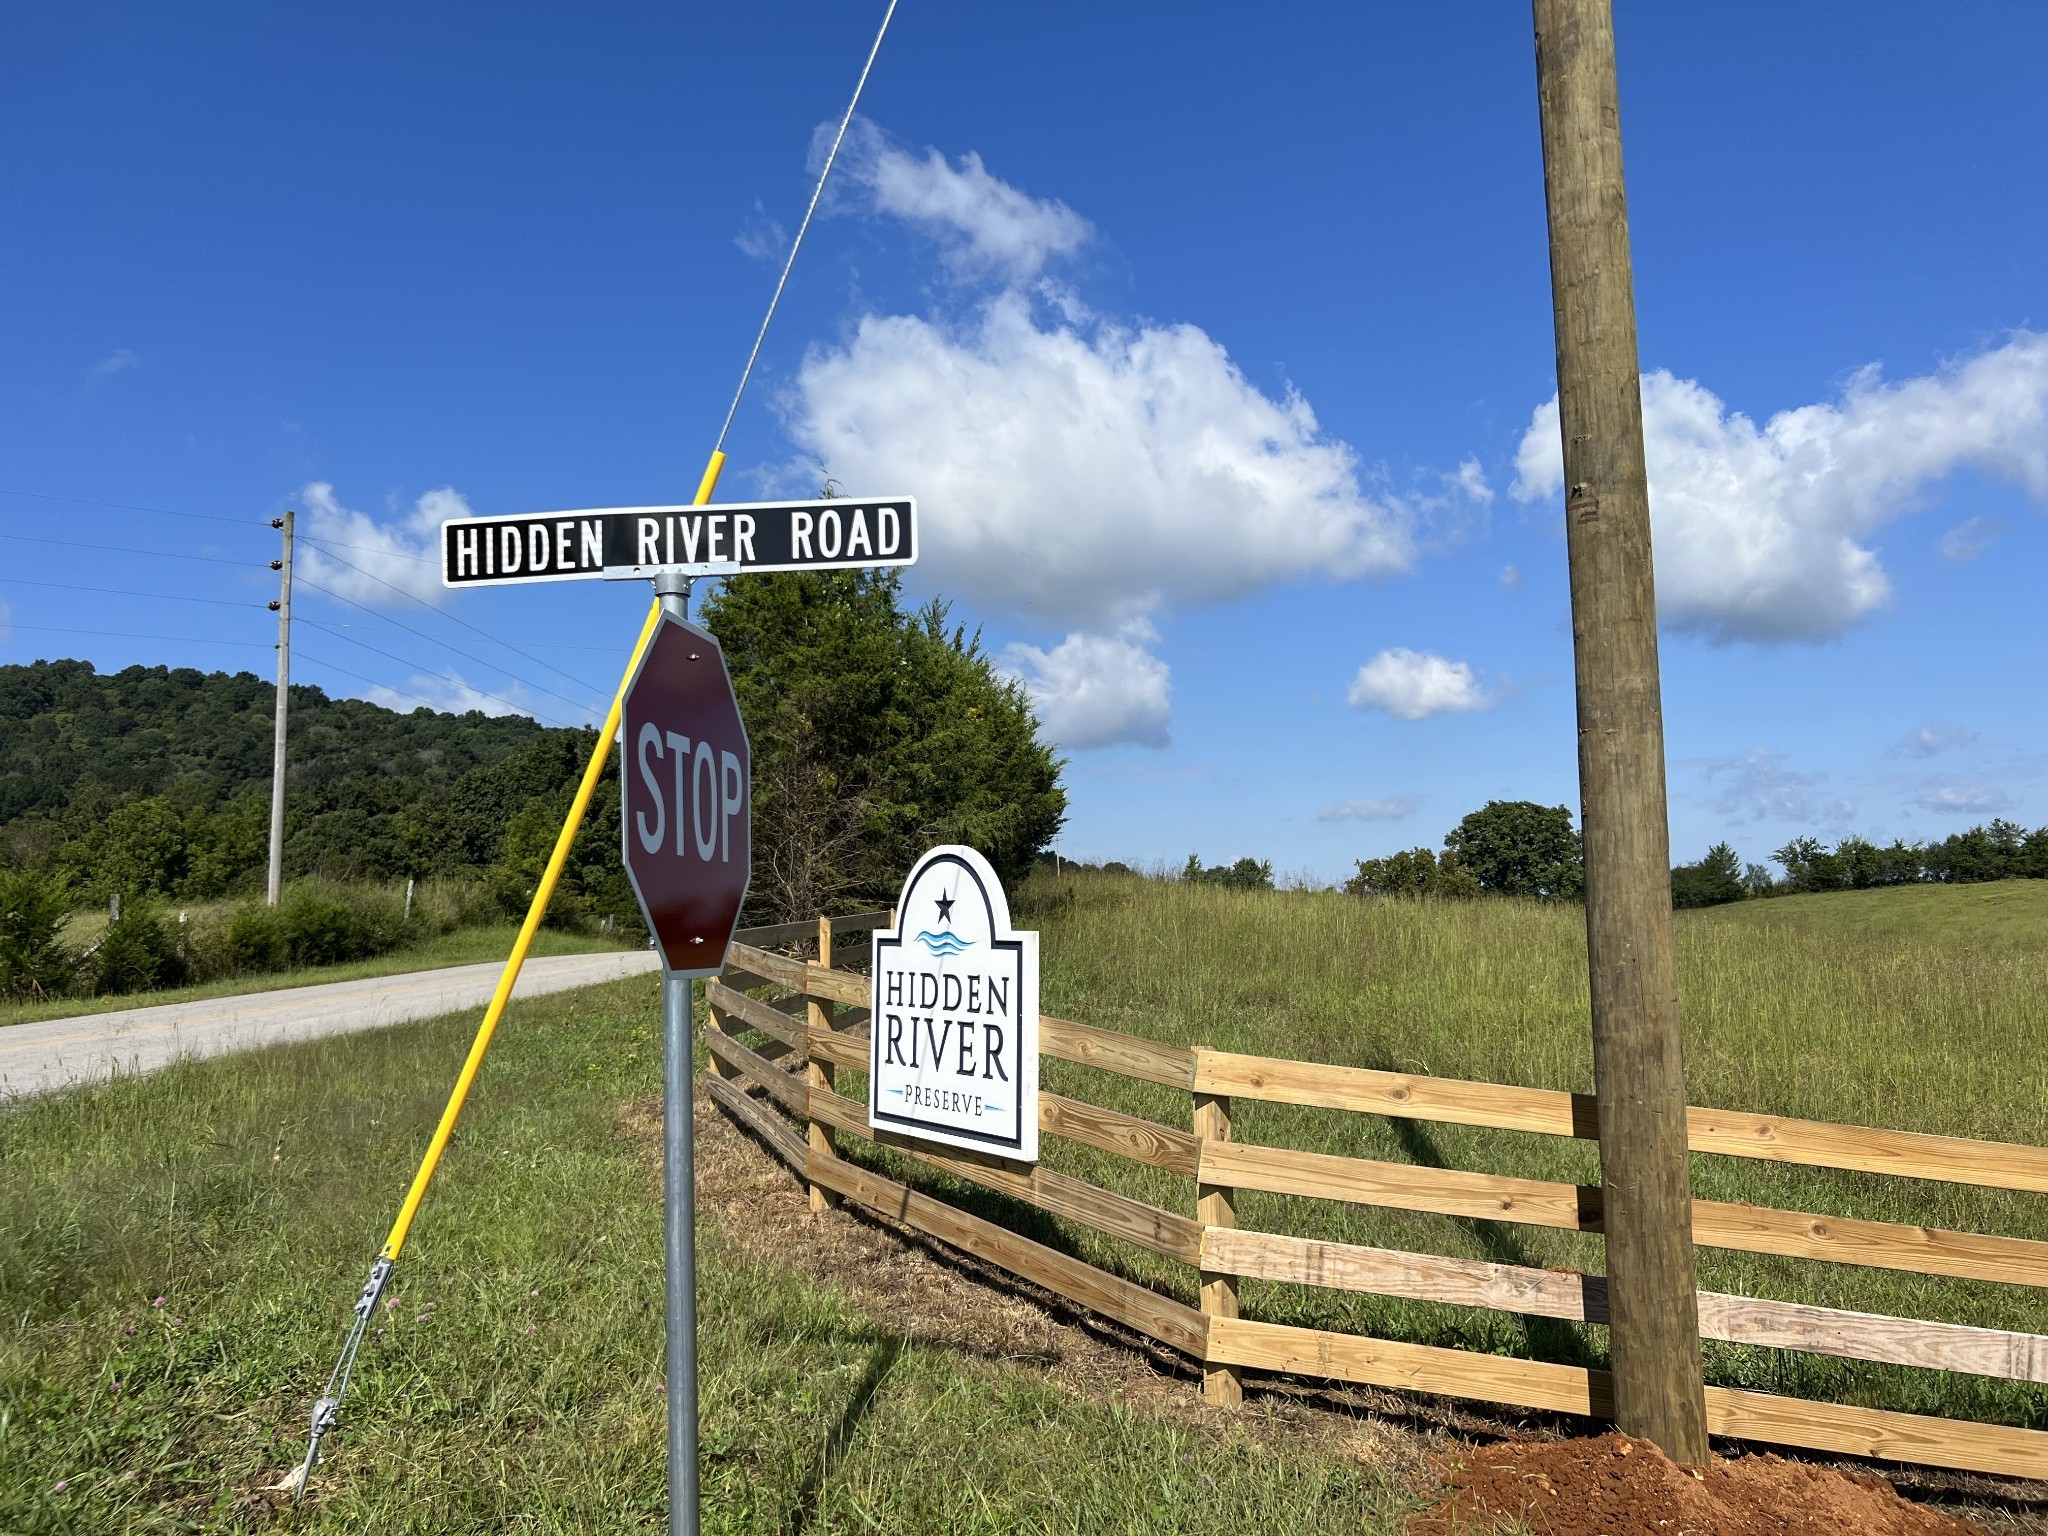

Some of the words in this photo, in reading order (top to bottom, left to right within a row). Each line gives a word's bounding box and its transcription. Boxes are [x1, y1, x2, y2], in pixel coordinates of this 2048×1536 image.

[456, 519, 603, 577] HIDDEN
[637, 513, 756, 565] RIVER
[791, 507, 901, 560] ROAD
[636, 722, 743, 863] STOP
[886, 970, 1010, 1017] HIDDEN
[884, 1013, 1009, 1082] RIVER
[904, 1084, 983, 1117] PRESERVE
